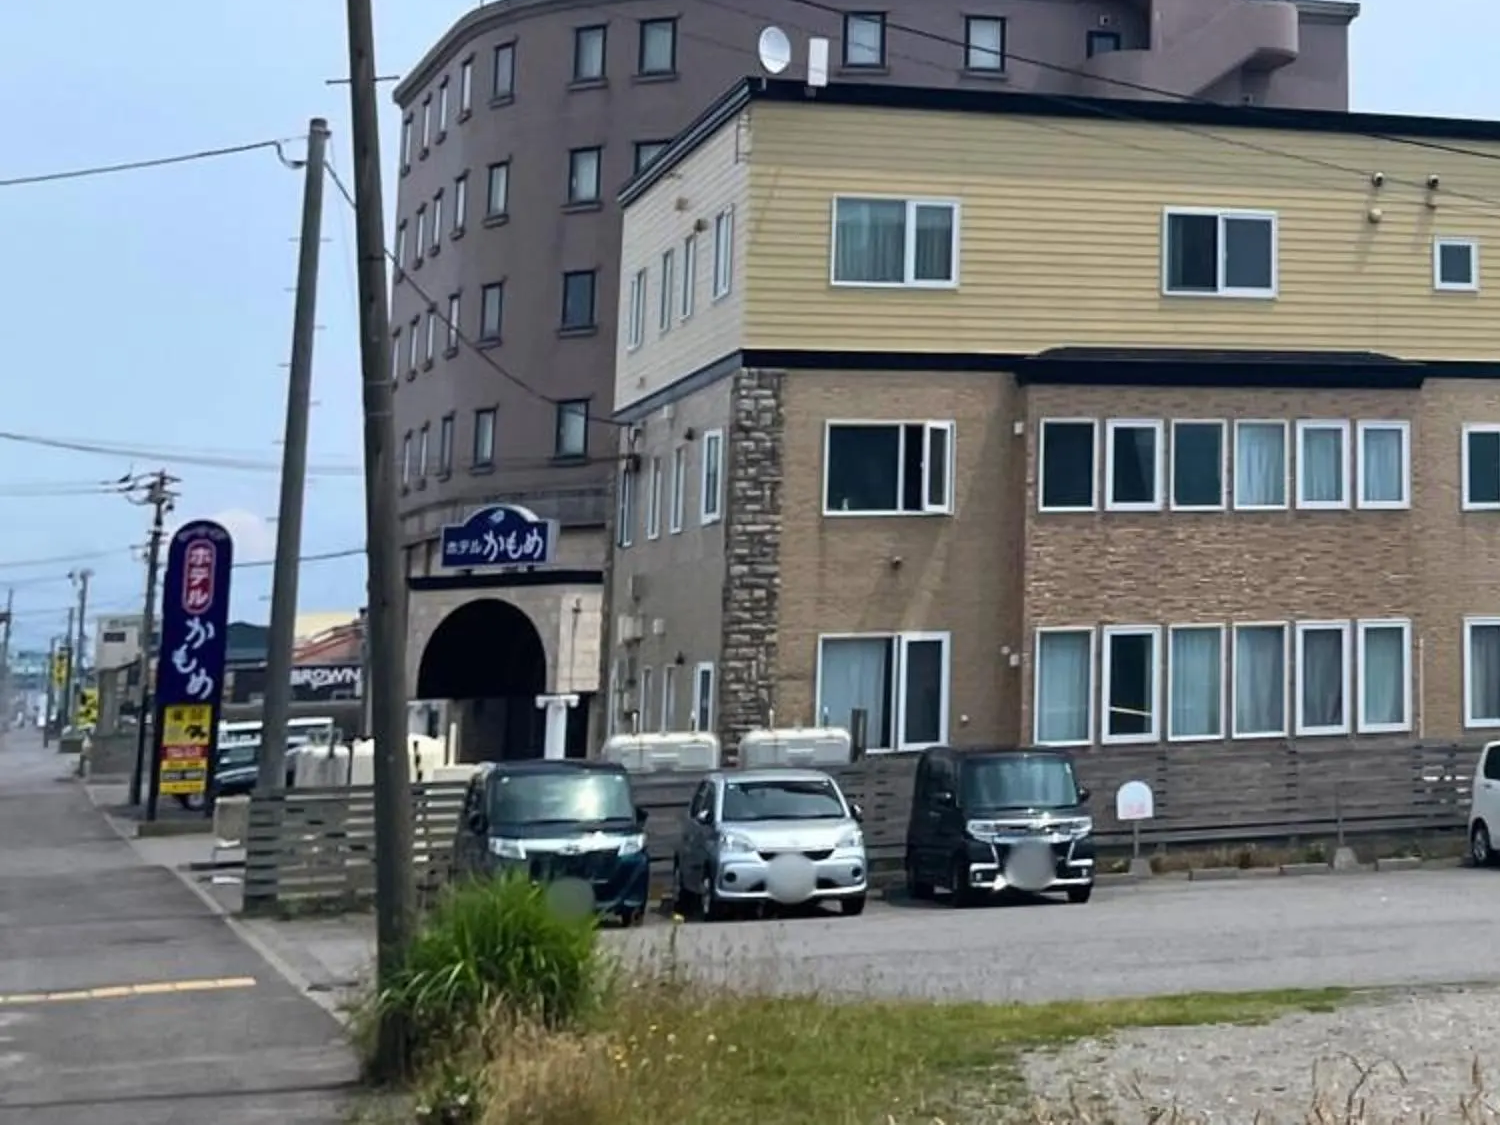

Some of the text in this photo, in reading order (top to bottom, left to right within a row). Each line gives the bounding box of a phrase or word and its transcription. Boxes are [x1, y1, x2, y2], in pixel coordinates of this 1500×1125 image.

[446, 527, 543, 562] ホテル かもめ
[187, 546, 211, 607] ホテル
[172, 616, 215, 700] かもめ
